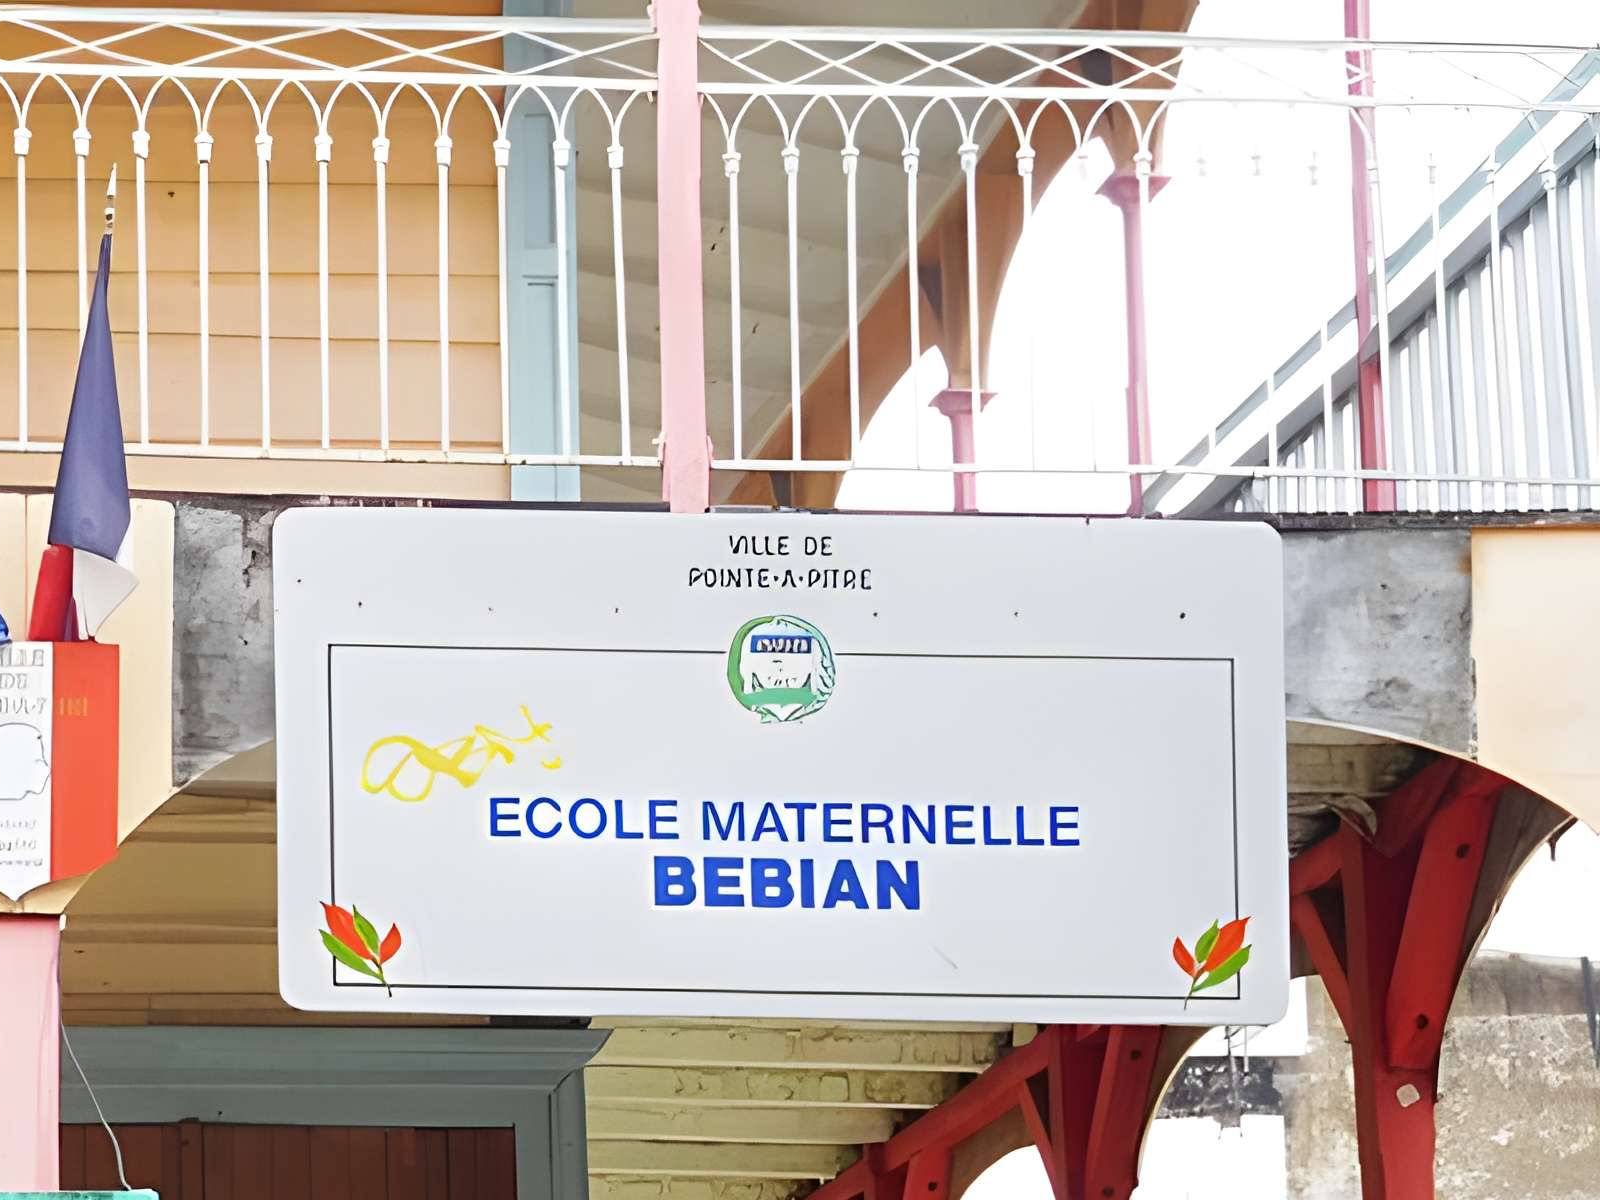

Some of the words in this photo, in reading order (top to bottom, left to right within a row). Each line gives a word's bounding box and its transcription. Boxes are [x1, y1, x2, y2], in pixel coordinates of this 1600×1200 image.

[729, 535, 790, 556] VILLE
[804, 536, 833, 556] DE
[489, 797, 680, 839] ECOLE
[702, 800, 1081, 846] MATERNELLE
[653, 856, 921, 910] BEBIAN
